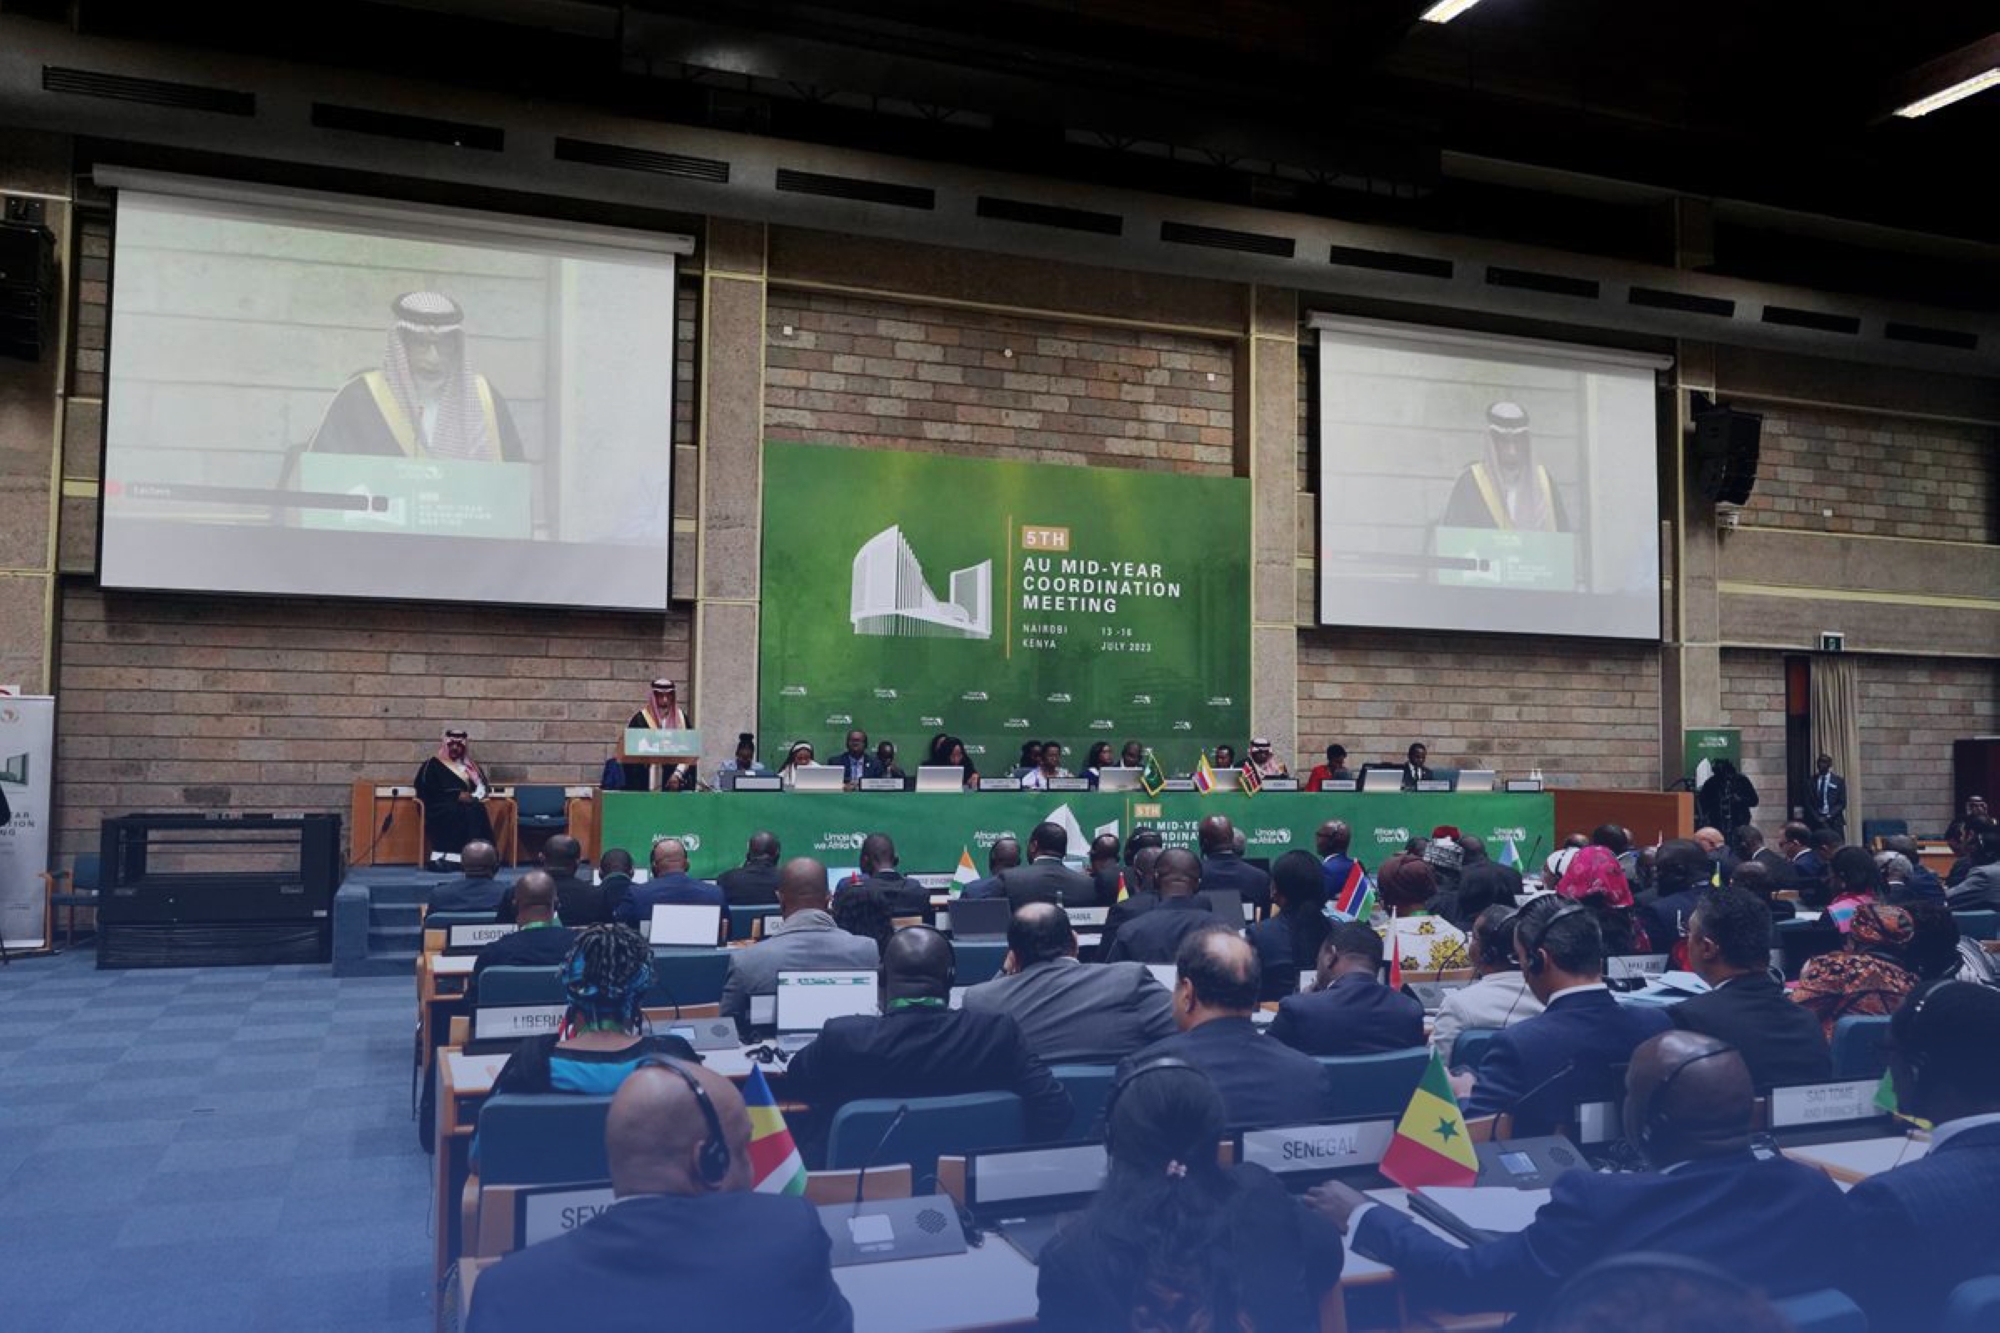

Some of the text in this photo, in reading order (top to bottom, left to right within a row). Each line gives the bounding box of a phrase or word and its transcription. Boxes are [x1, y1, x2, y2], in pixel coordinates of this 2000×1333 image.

[1026, 531, 1065, 546] 5TH
[1023, 557, 1162, 578] AU MID-YEAR
[1023, 576, 1181, 598] COORDINATION
[1023, 595, 1117, 613] MEETING
[1023, 624, 1068, 635] NAIROBI
[1022, 638, 1057, 649] KENYA
[1101, 641, 1151, 653] JULY 2023
[1282, 1137, 1358, 1160] SENEGAL
